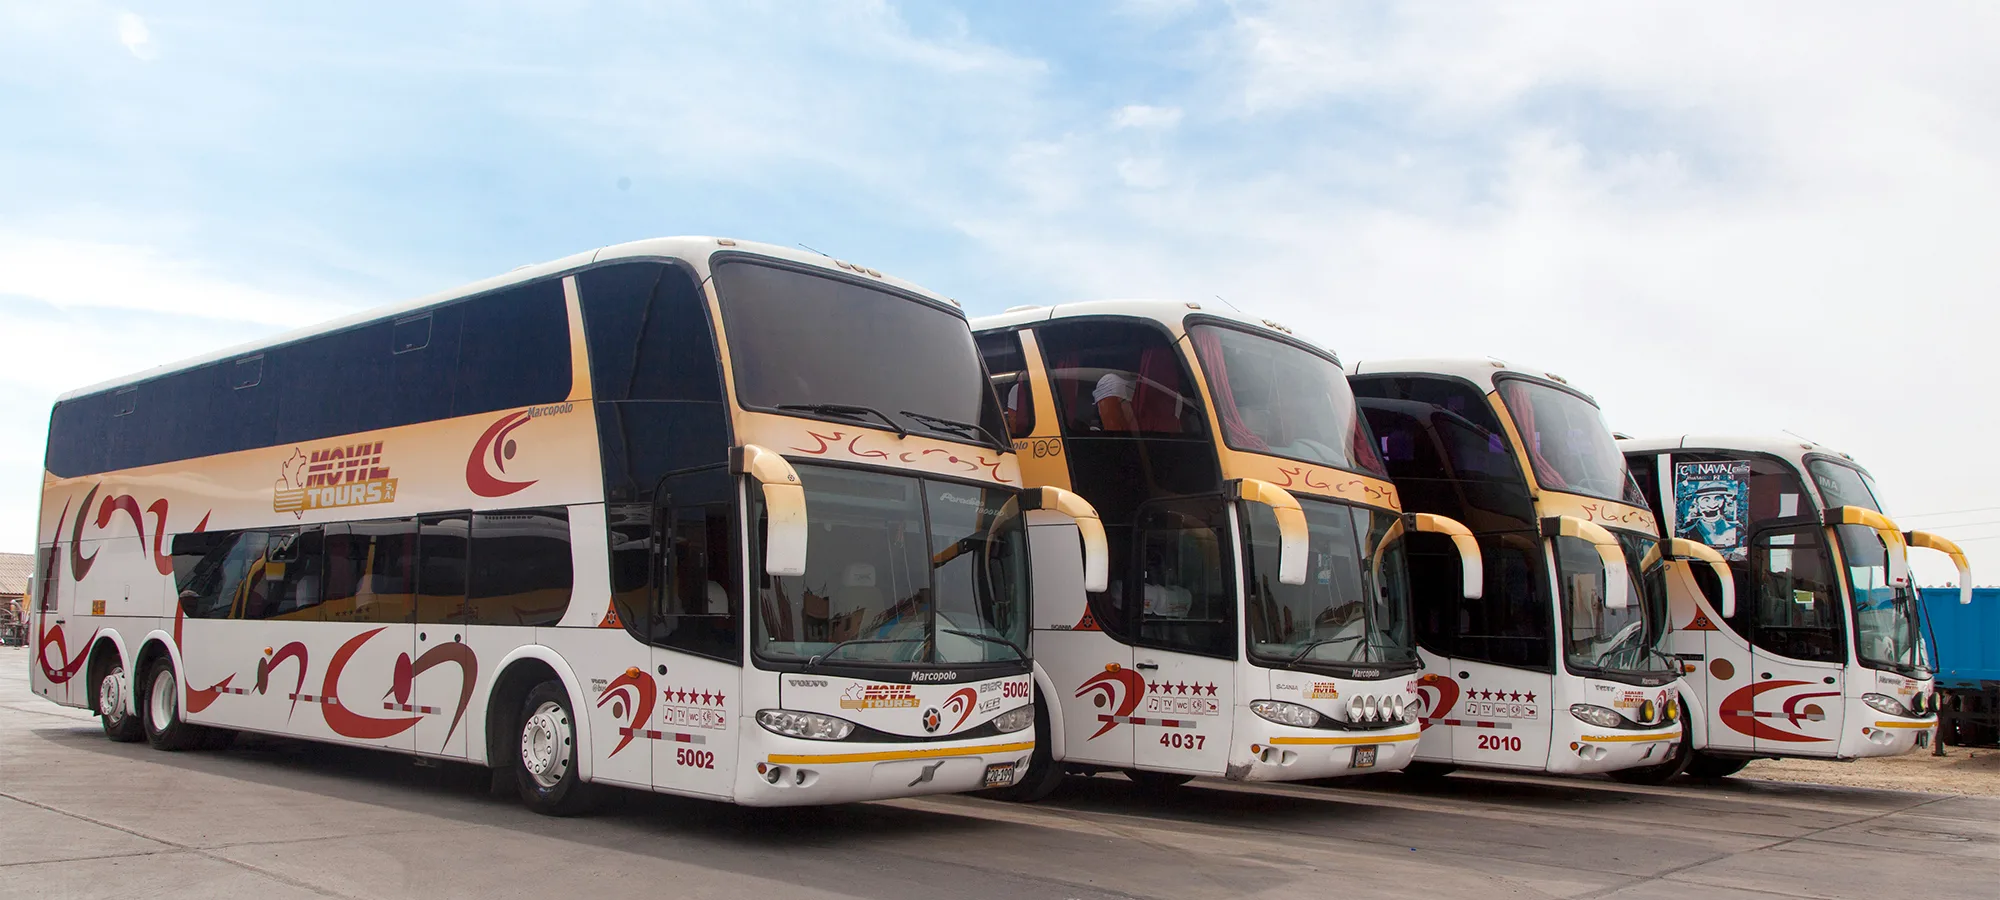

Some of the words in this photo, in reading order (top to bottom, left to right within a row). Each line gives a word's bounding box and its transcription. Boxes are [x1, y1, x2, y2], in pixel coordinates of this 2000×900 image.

[527, 402, 573, 418] Marcopolo
[305, 440, 390, 487] MOVIL
[1679, 463, 1733, 476] CARNAVAL
[308, 482, 382, 508] TOURS
[911, 671, 957, 681] Marcopolo
[1352, 669, 1380, 678] Marcopolo
[788, 679, 828, 688] VOLVO
[1003, 682, 1029, 698] 5002
[864, 685, 916, 700] MOVIL
[866, 699, 913, 709] TOURS
[1177, 702, 1188, 710] WC
[677, 710, 686, 719] TV
[689, 713, 699, 722] WC
[1160, 732, 1206, 750] 4037
[1477, 734, 1522, 752] 2010
[676, 747, 715, 769] 5002
